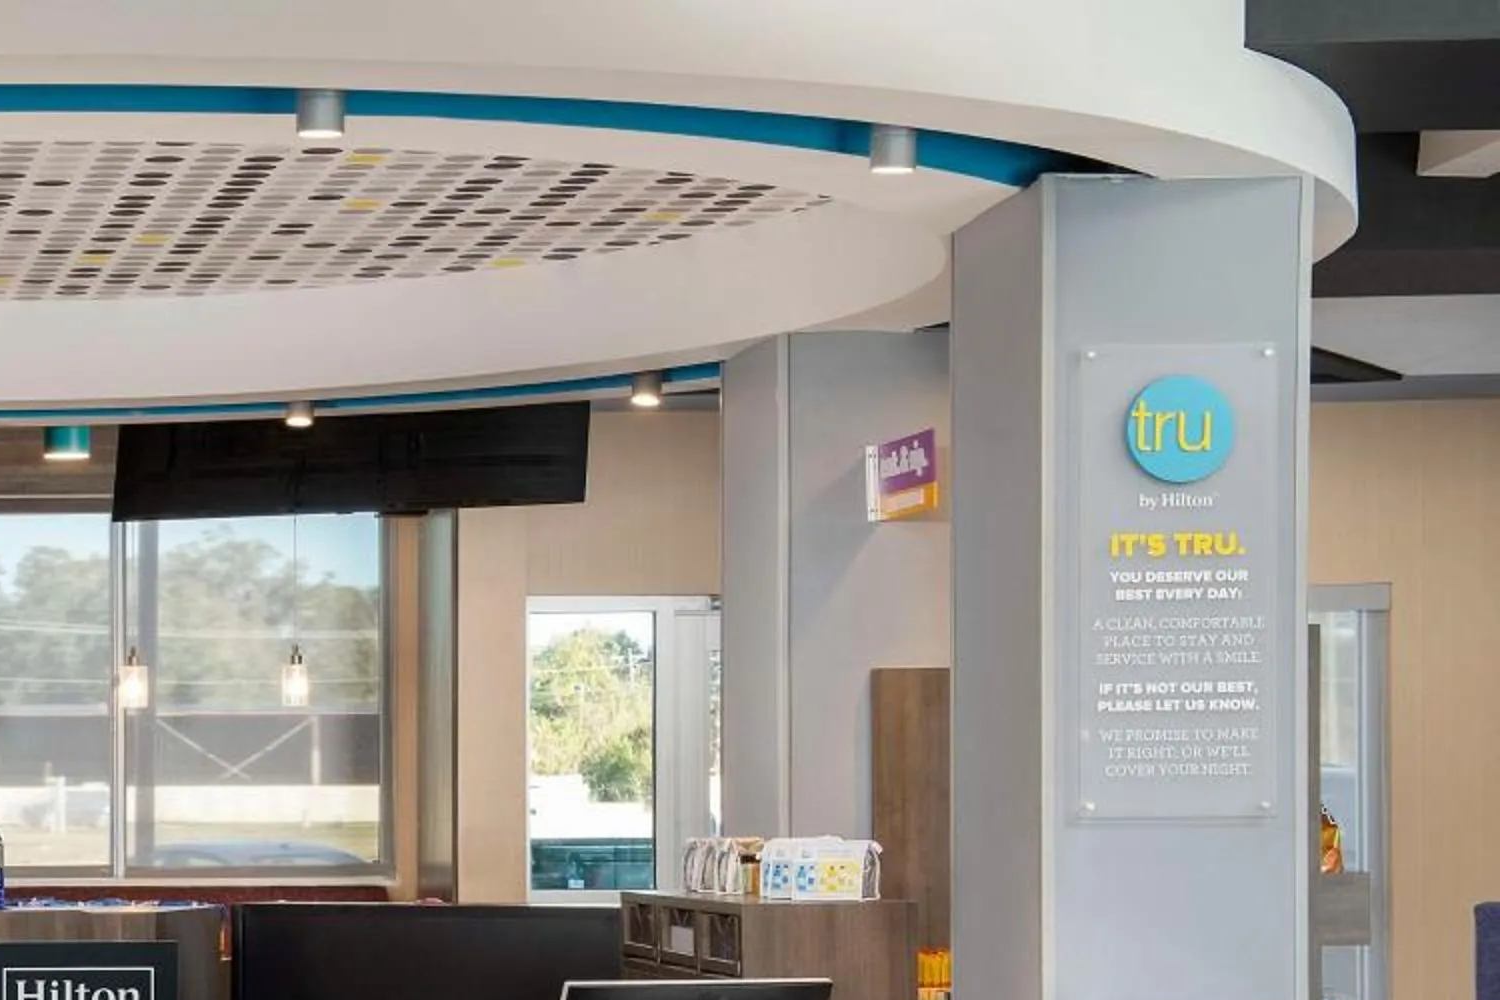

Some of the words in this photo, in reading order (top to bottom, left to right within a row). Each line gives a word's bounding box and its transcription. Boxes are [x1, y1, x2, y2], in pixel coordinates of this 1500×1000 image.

[1131, 398, 1213, 454] tru
[1138, 493, 1158, 510] by
[1161, 492, 1213, 508] Hilton
[1109, 531, 1167, 558] IT'S
[1173, 530, 1246, 557] TRU.
[1109, 571, 1142, 583] YOU
[1145, 570, 1213, 583] DESERVE
[1215, 569, 1249, 582] OUR
[1115, 589, 1153, 601] BEST
[1155, 588, 1203, 600] EVERY
[1092, 619, 1104, 631] A
[1158, 616, 1265, 630] COMFORTABLE
[1103, 635, 1154, 648] PLACE
[1155, 635, 1175, 647] TO
[1178, 634, 1220, 647] STAY
[1221, 633, 1255, 646] AND
[1096, 652, 1156, 665] SERVICE
[1158, 651, 1200, 665] WITH
[1202, 651, 1213, 664] A
[1098, 683, 1114, 695] IF
[1116, 682, 1143, 695] IT'S
[1145, 682, 1178, 694] NOT
[1180, 681, 1213, 694] OUR
[1217, 681, 1259, 695] BEST,
[1097, 700, 1152, 712] PLEASE
[1155, 699, 1182, 711] LET
[1184, 699, 1205, 711] US
[1209, 698, 1261, 711] KNOW.
[1098, 729, 1123, 742] WE
[1125, 728, 1190, 741] PROMISE
[1193, 728, 1214, 741] TO
[1217, 727, 1260, 741] MAKE
[1109, 747, 1124, 759] IT
[1180, 745, 1203, 757] OR
[1105, 764, 1156, 777] COVER
[1158, 763, 1200, 776] YOUR
